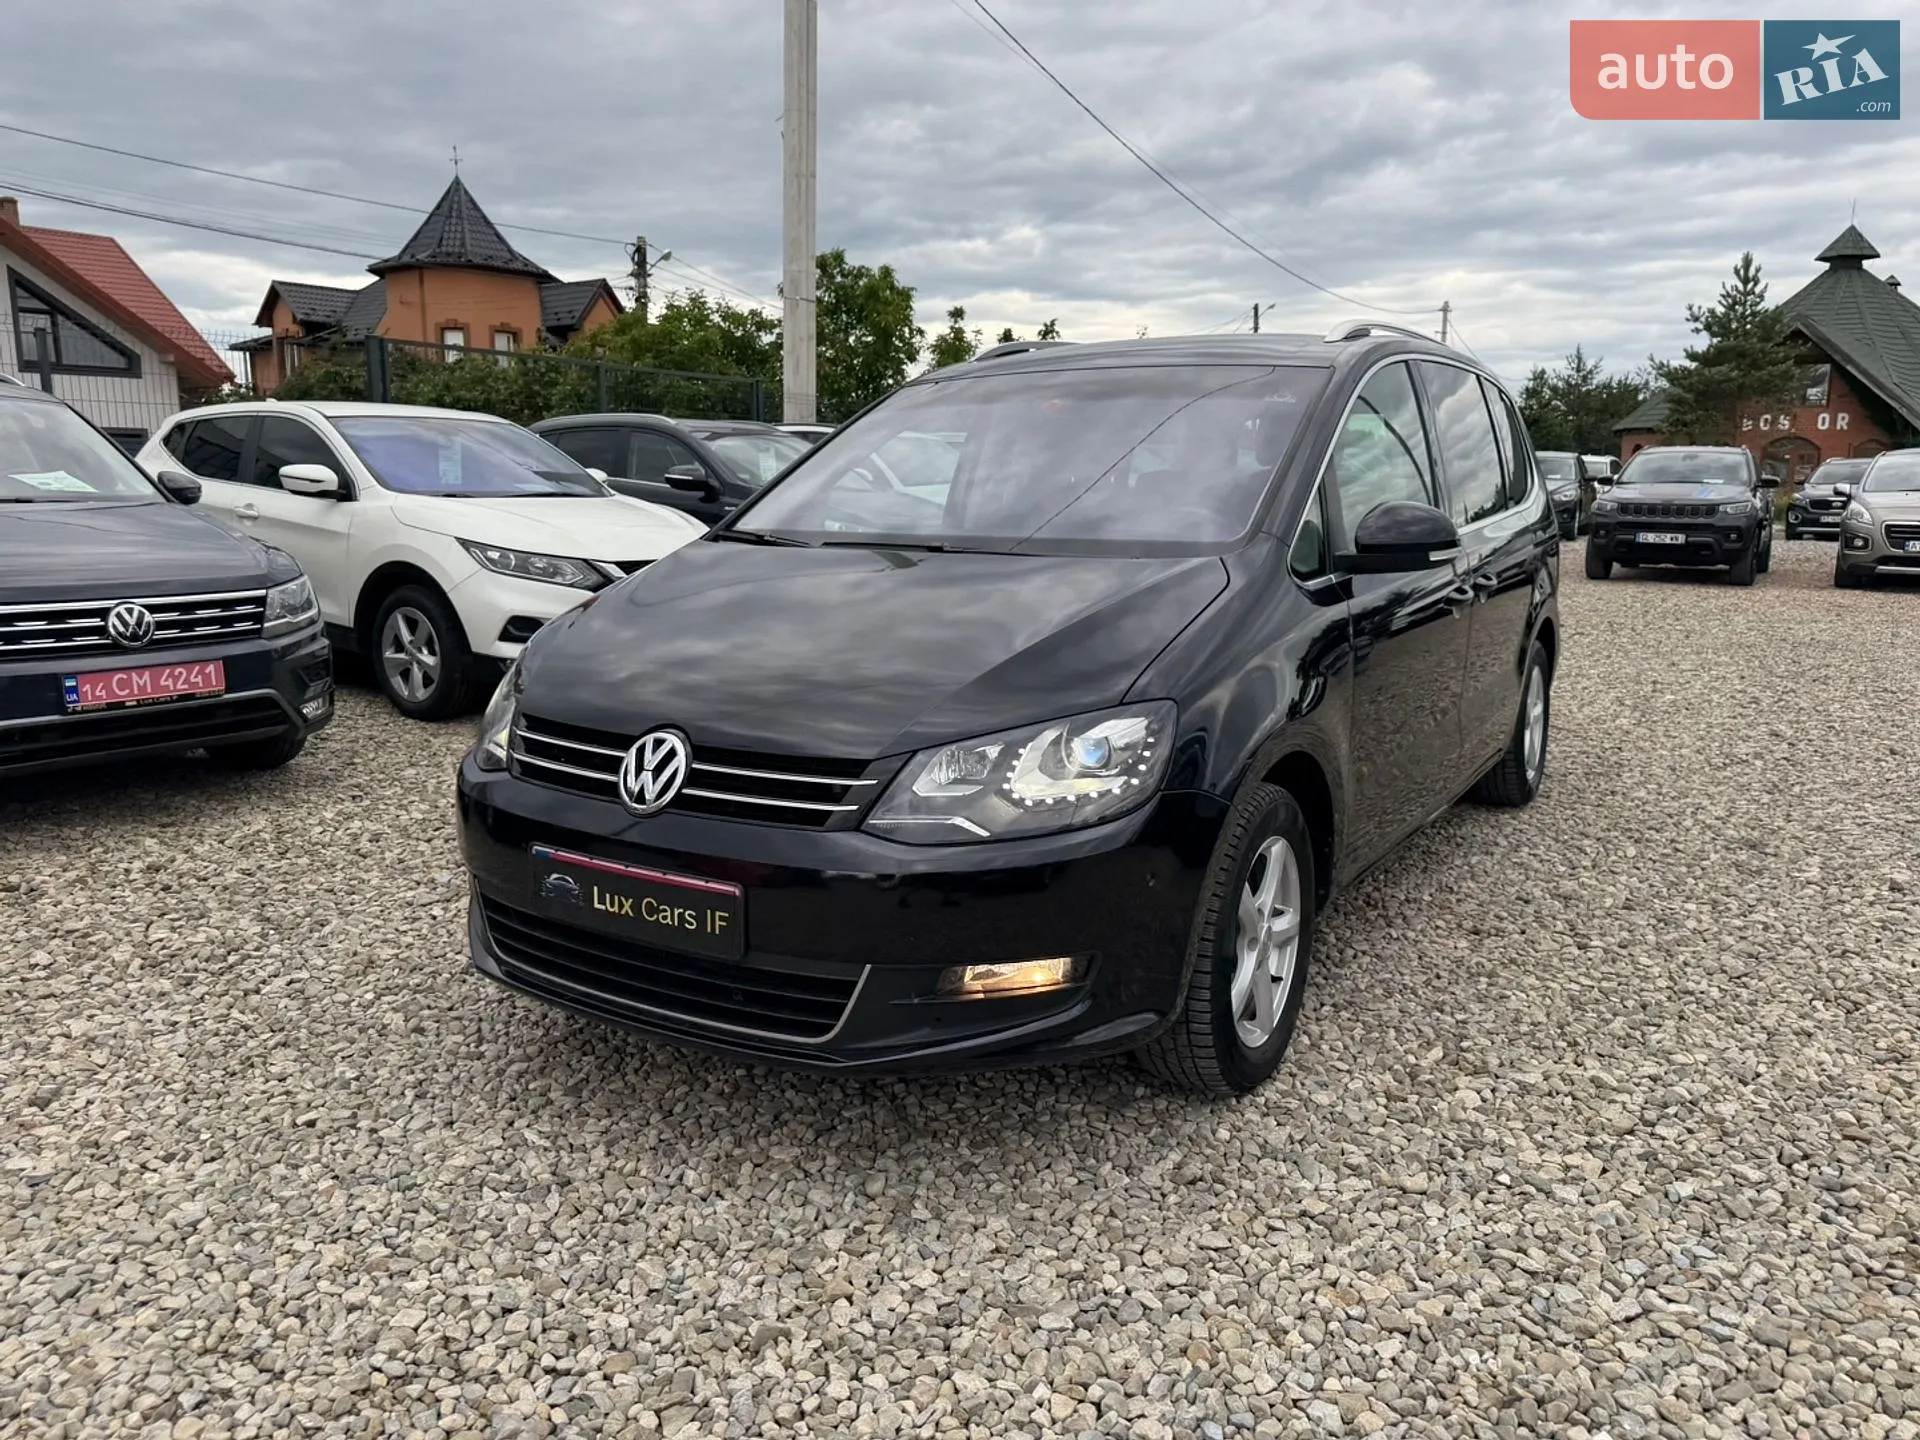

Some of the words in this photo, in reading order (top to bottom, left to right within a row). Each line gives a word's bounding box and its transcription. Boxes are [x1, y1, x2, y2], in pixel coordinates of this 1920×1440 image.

[66, 694, 79, 702] UA
[82, 682, 107, 701] 14
[112, 671, 152, 696] CM
[160, 664, 217, 691] 4241
[593, 886, 633, 917] Lux
[641, 897, 697, 930] Cars
[706, 909, 729, 935] IF
